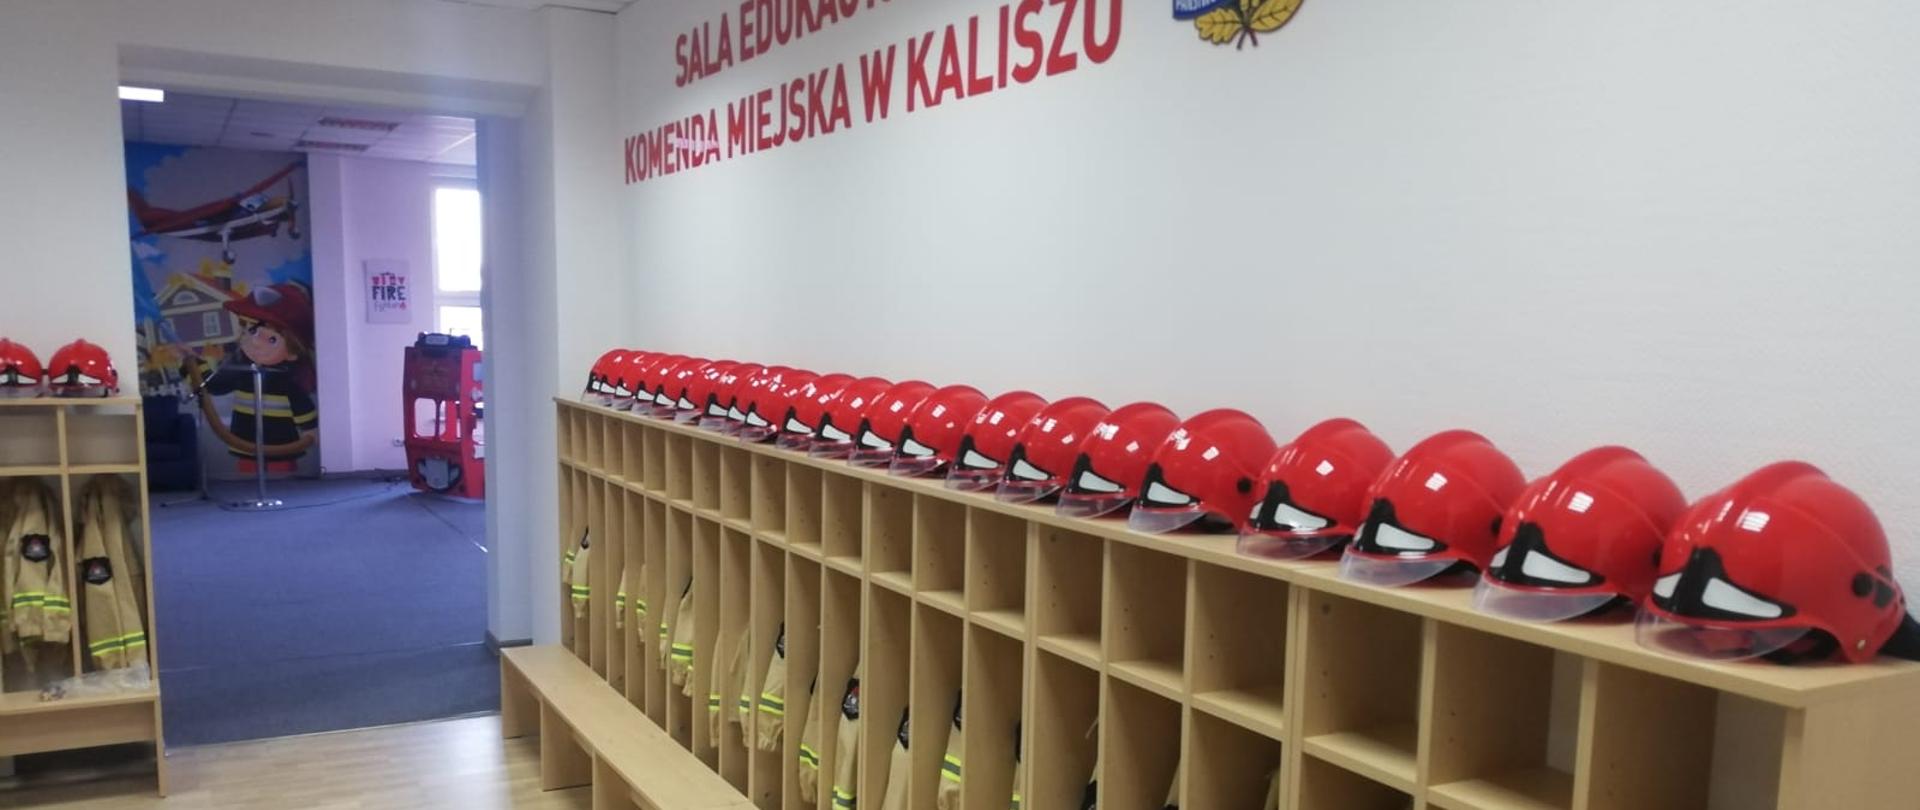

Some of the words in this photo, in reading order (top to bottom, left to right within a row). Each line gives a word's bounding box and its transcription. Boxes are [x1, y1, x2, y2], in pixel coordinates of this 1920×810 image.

[675, 12, 733, 88] SALA
[624, 108, 721, 185] KOMENDA
[727, 62, 852, 158] MIEJSKA
[859, 44, 896, 123] W
[906, 0, 1122, 113] KALISZU
[372, 285, 406, 301] FIRE
